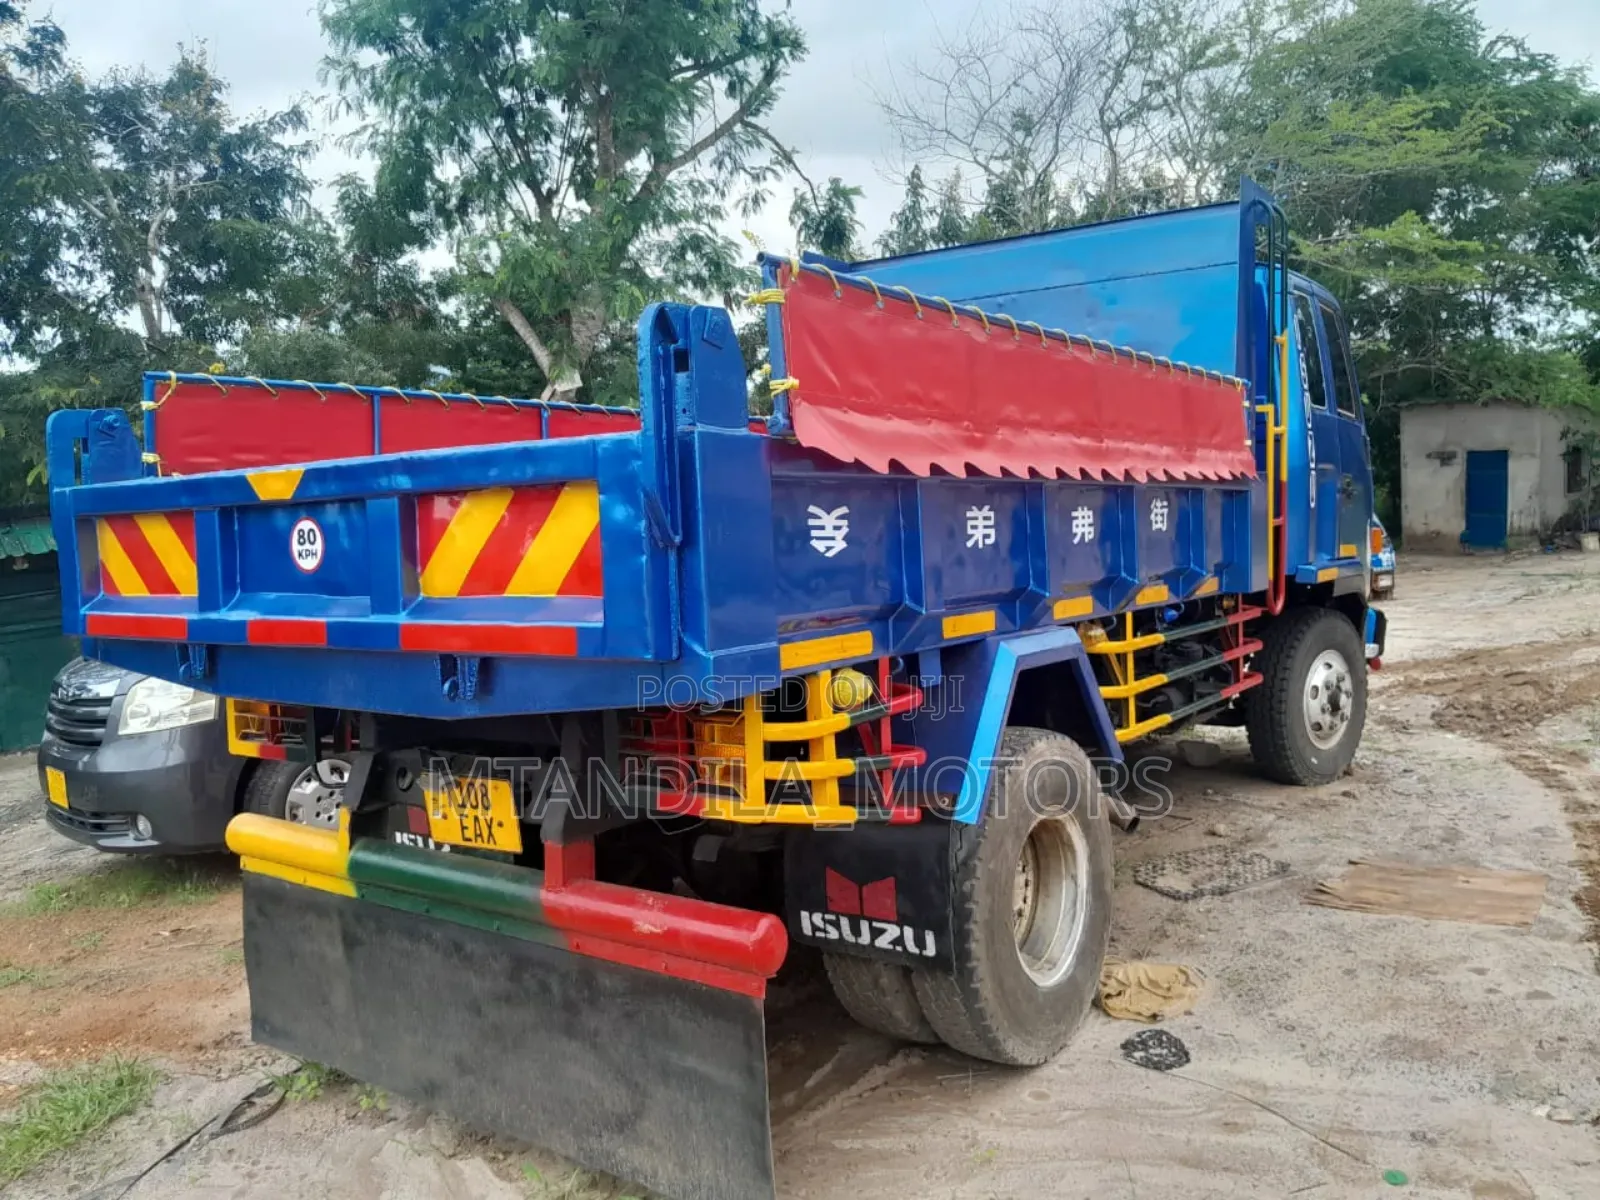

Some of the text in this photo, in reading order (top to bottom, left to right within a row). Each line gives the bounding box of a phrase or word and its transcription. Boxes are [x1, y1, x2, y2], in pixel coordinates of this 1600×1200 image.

[297, 528, 317, 545] 80
[966, 504, 996, 549] 弟
[1150, 496, 1168, 533] 街
[297, 548, 318, 560] KPH
[459, 813, 497, 846] EAX
[799, 909, 937, 958] ISUZU
